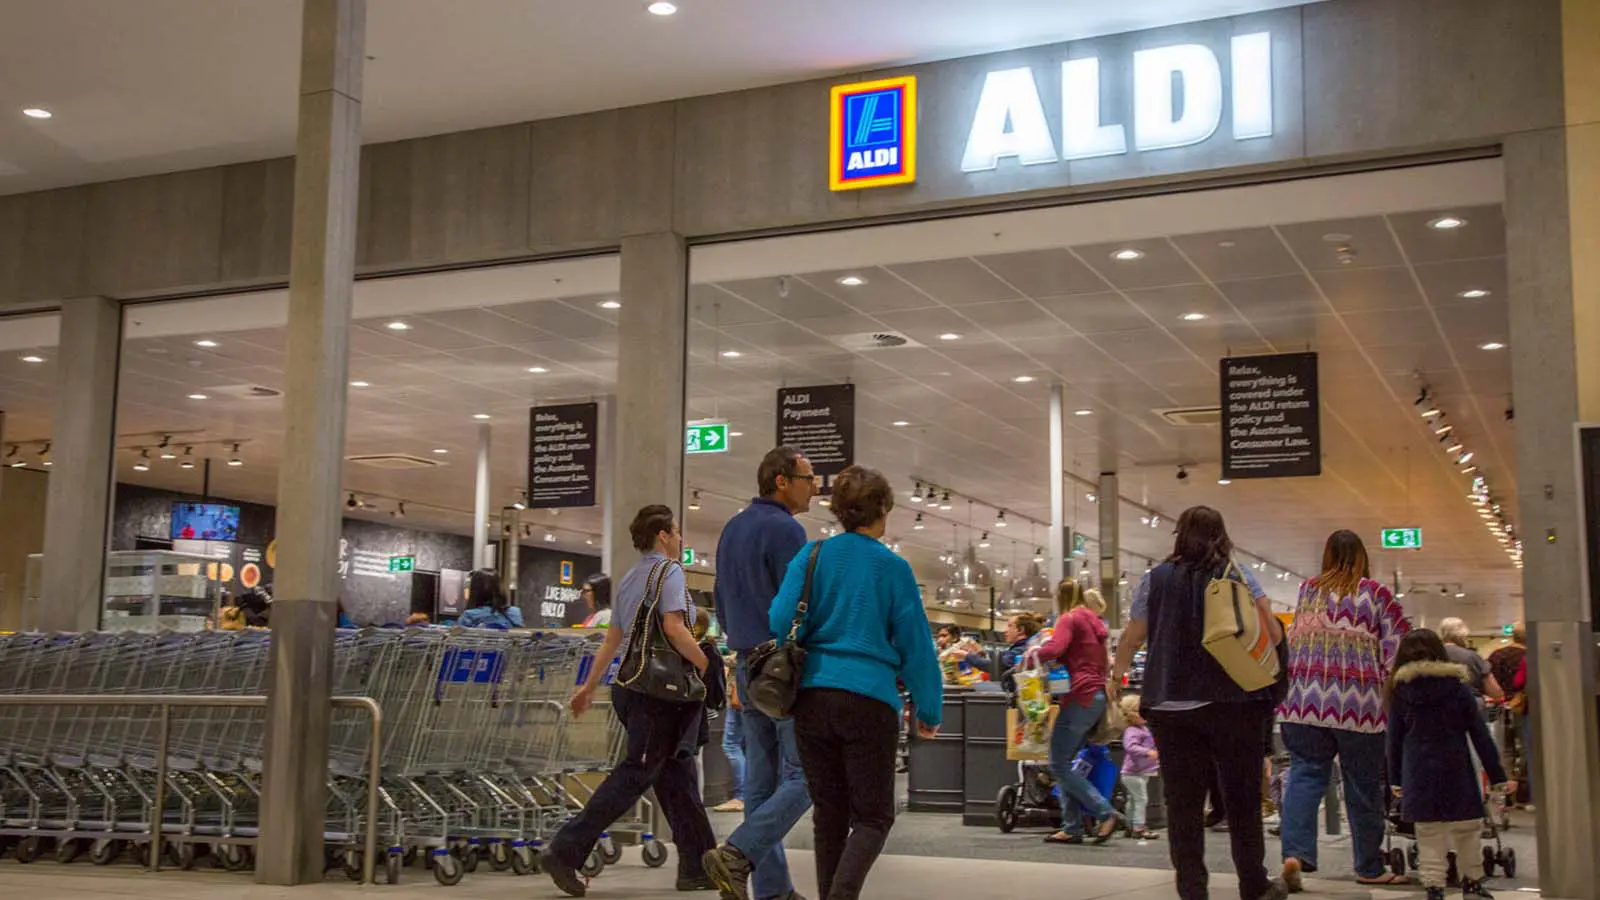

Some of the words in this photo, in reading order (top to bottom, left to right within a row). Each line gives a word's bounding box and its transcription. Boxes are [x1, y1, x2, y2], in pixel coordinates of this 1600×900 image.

[961, 31, 1272, 172] ALDI
[847, 147, 898, 170] ALDI
[1229, 366, 1261, 375] Relax,
[1229, 376, 1286, 389] everything
[1288, 375, 1297, 383] is
[784, 394, 809, 405] ALDI
[1229, 388, 1271, 400] covered
[1272, 386, 1304, 397] under
[1230, 403, 1247, 412] the
[1249, 401, 1274, 411] ALDI
[1276, 401, 1309, 409] return
[784, 407, 830, 420] Payment
[1230, 414, 1262, 426] policy
[1264, 412, 1284, 422] and
[1230, 428, 1248, 437] the
[1249, 424, 1302, 436] Australian
[1230, 440, 1283, 449] Consumer
[1285, 438, 1310, 446] Law.
